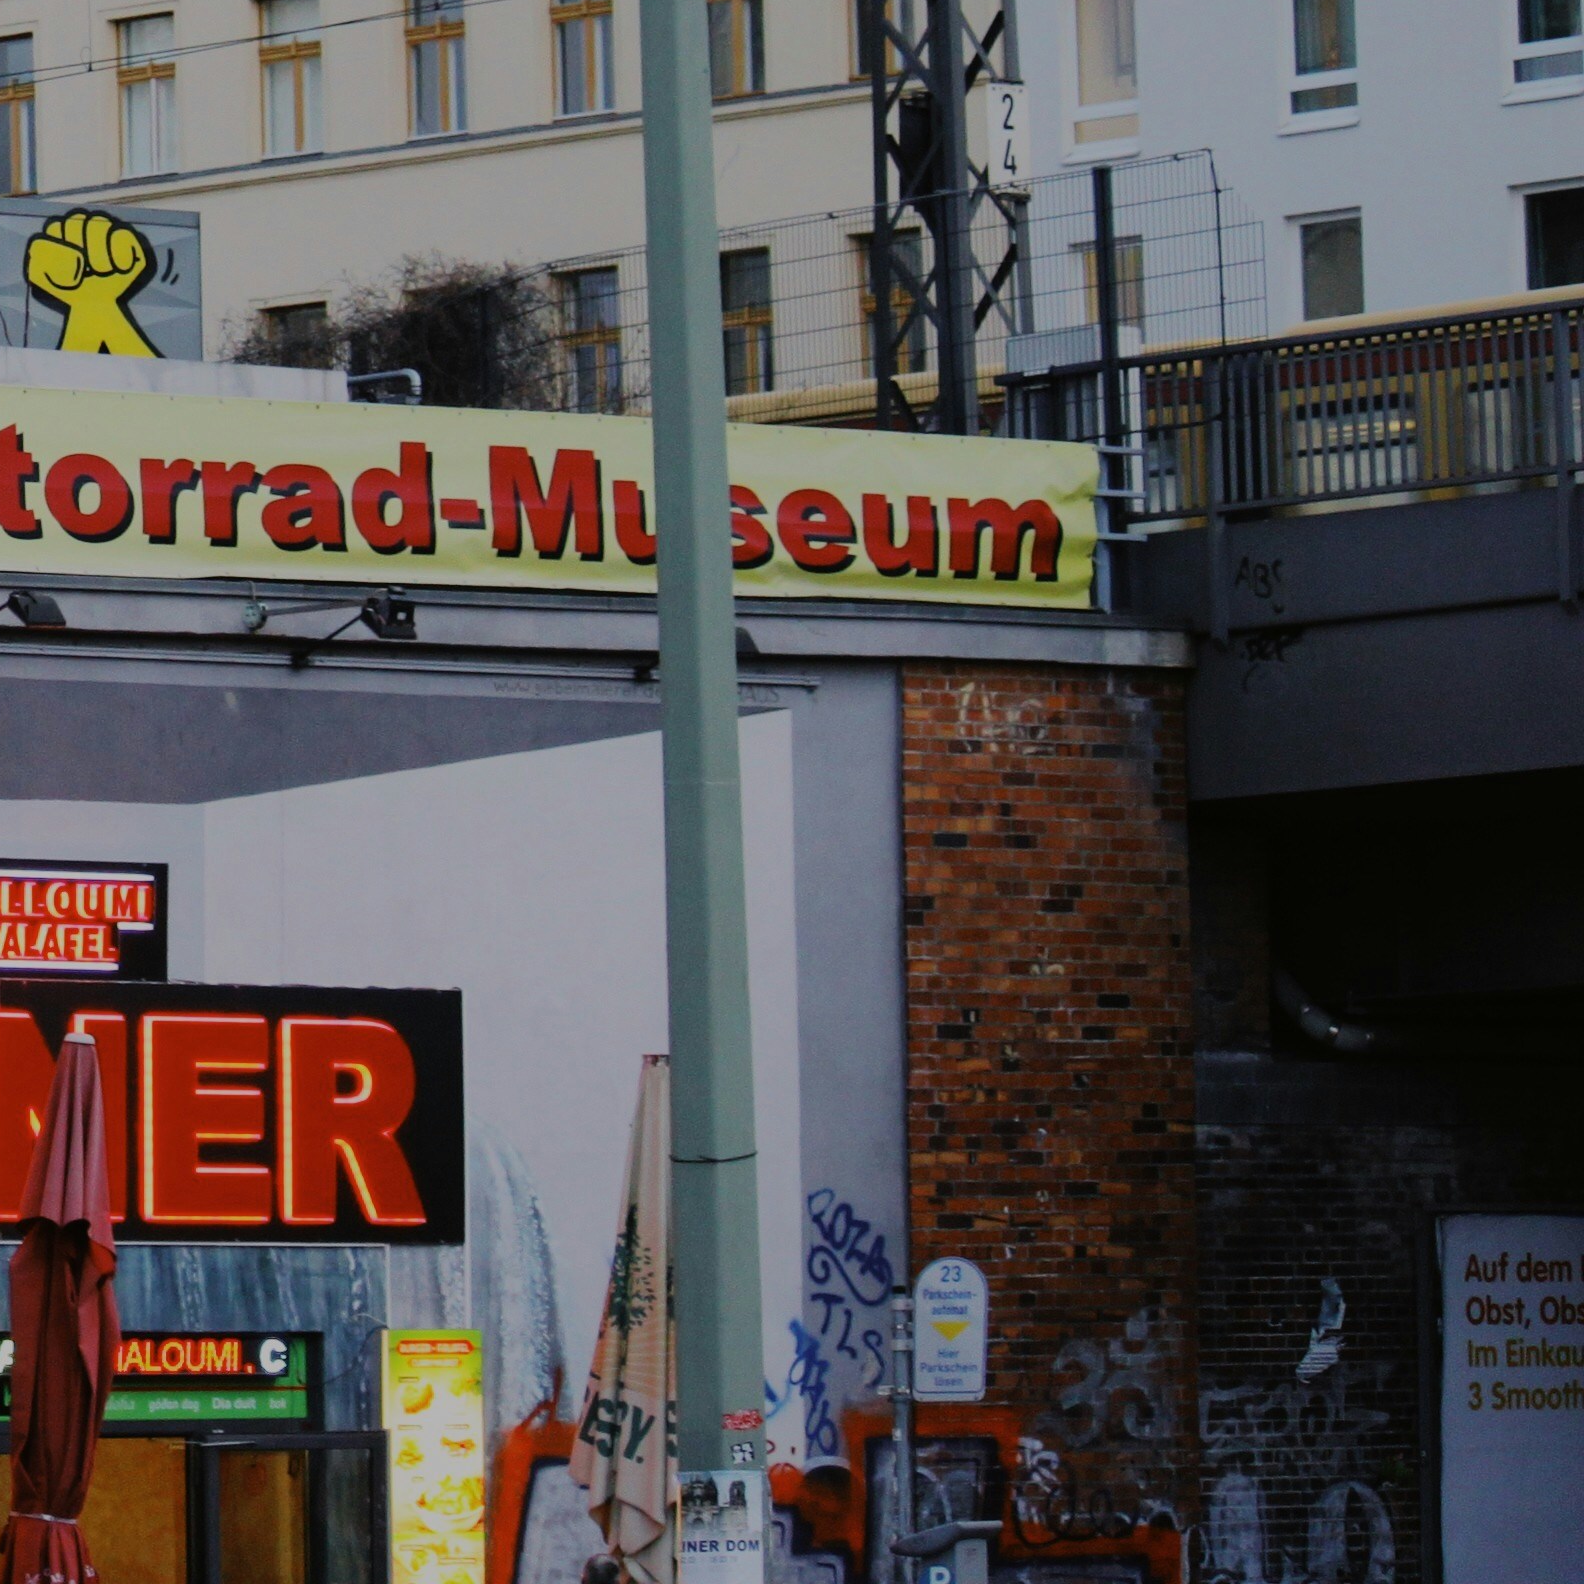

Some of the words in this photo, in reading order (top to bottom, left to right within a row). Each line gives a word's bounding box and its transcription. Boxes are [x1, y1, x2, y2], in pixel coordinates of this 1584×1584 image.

[940, 1265, 962, 1283] 23
[1464, 1252, 1509, 1283] Auf
[1516, 1253, 1572, 1283] dem
[1465, 1295, 1531, 1329] Obst,
[1540, 1295, 1584, 1325] Obs
[1467, 1340, 1498, 1367] Im
[1468, 1381, 1482, 1411] 3
[726, 1540, 760, 1552] DOM
